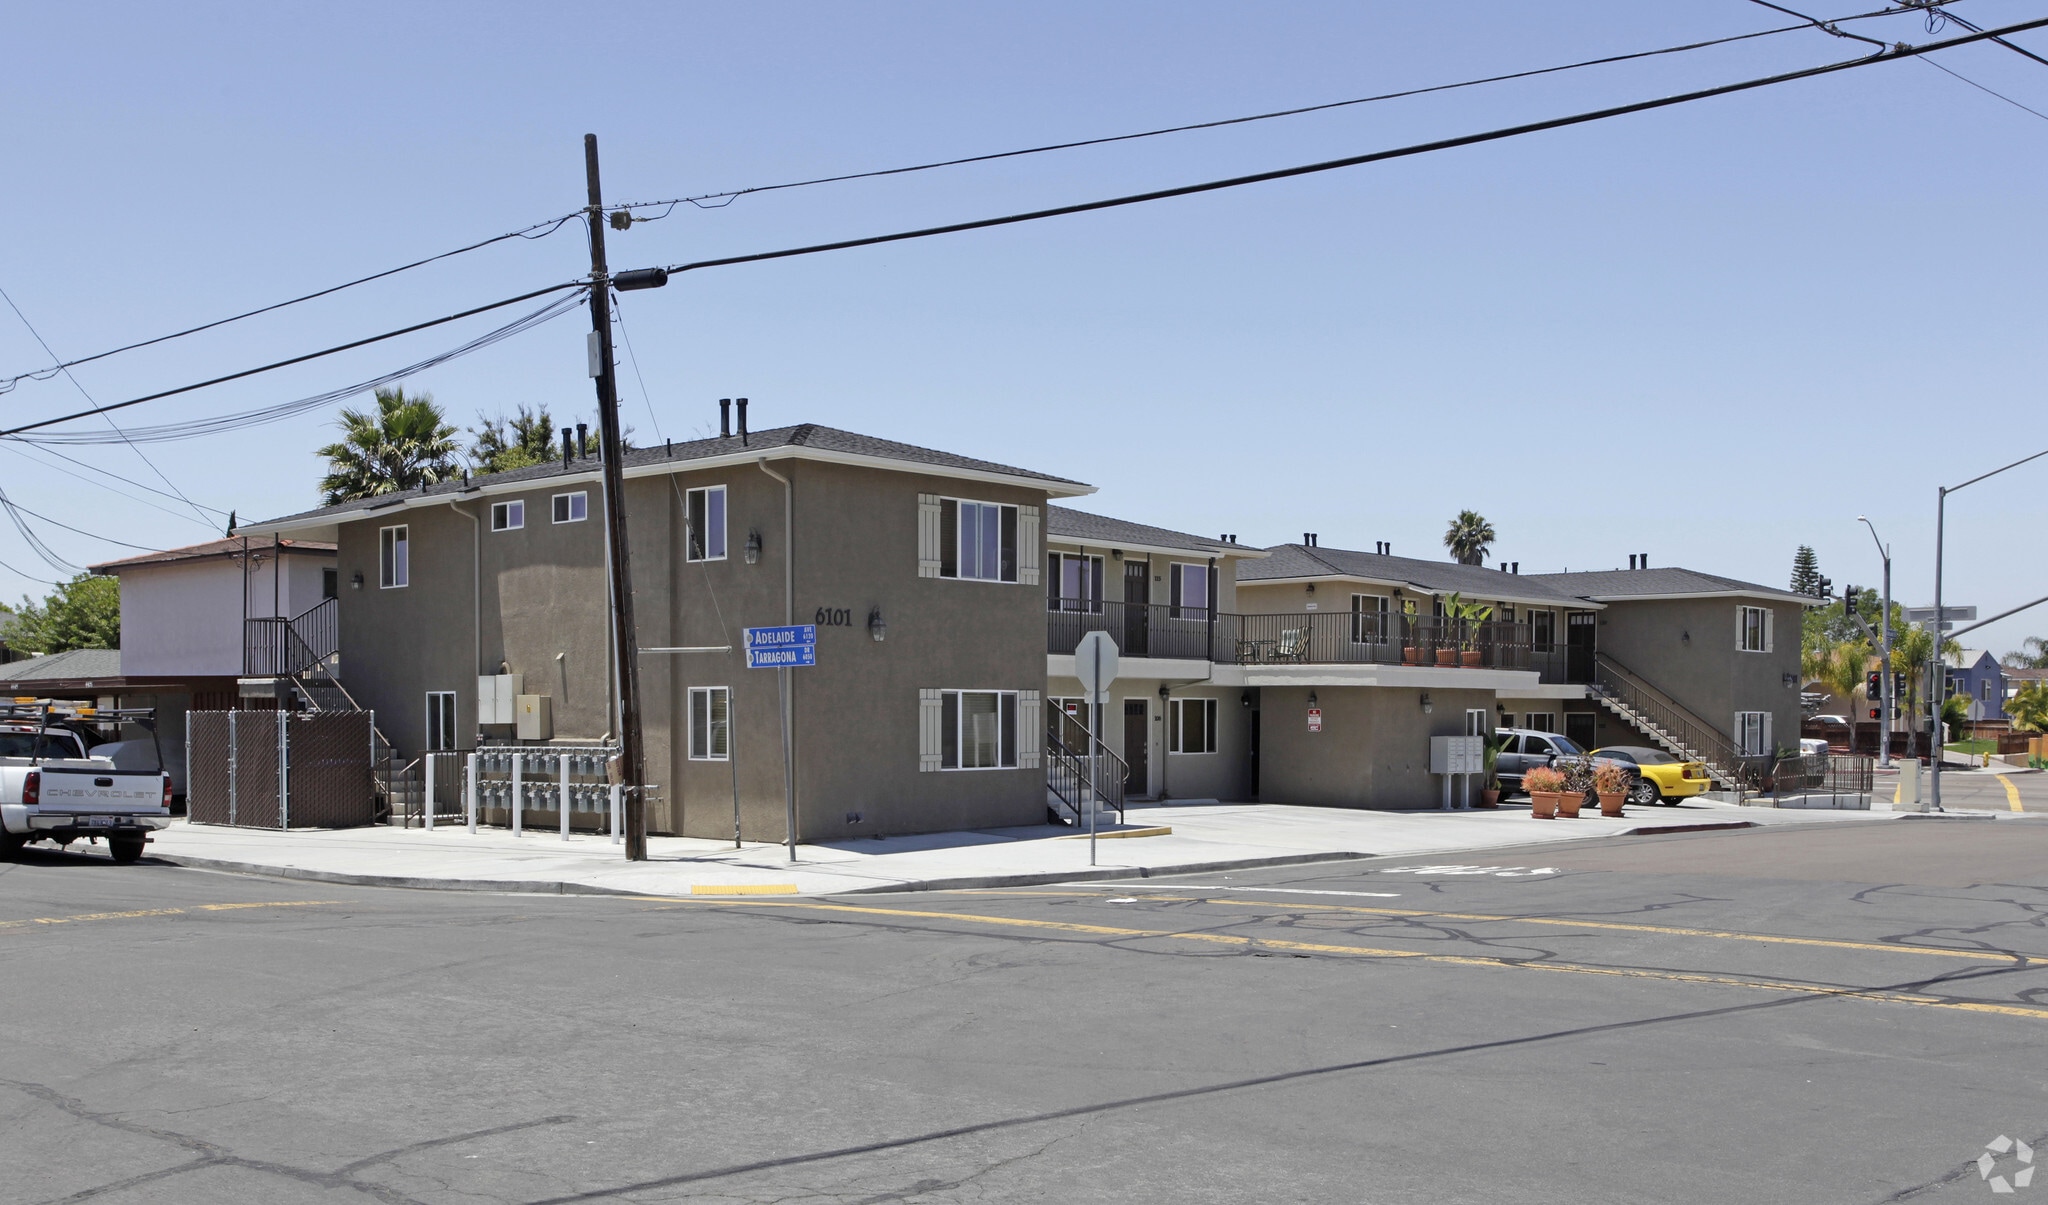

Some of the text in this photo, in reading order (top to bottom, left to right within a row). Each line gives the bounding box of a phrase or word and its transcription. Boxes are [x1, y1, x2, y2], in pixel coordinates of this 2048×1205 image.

[815, 607, 852, 627] 6101
[755, 631, 795, 645] ADELAIDE
[754, 650, 797, 664] TARRAGONA
[47, 788, 157, 799] CHEVROLET
